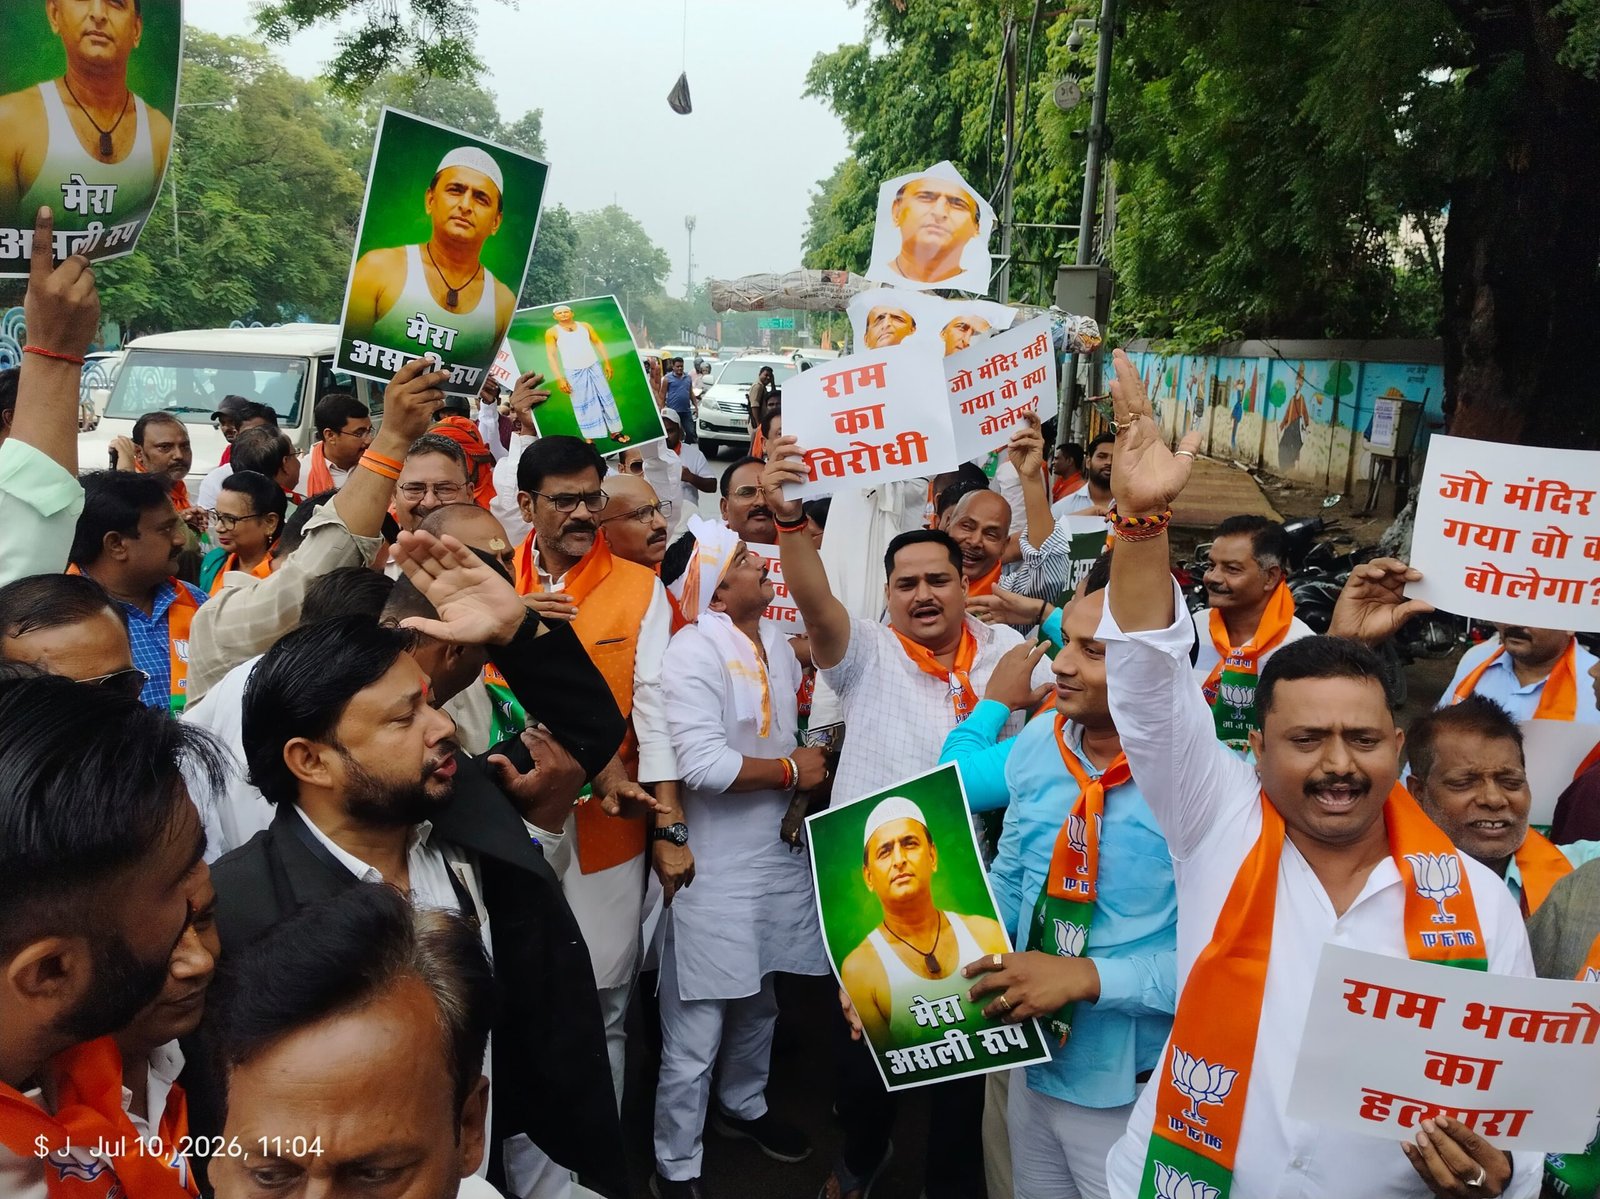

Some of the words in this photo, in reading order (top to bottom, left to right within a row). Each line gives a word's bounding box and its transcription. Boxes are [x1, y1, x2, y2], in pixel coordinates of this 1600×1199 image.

[61, 173, 118, 215] मेरा
[407, 312, 459, 350] मेरा
[350, 340, 444, 375] असी
[948, 369, 973, 393] जो
[977, 354, 1018, 380] मंदिर
[1021, 331, 1048, 360] नहीं
[820, 362, 887, 398] राम
[959, 390, 995, 415] गया
[999, 379, 1018, 399] वो
[1021, 366, 1046, 389] क्या
[831, 403, 885, 434] का
[802, 431, 929, 482] विरोधी
[1439, 470, 1493, 505] जो
[1504, 476, 1597, 516] मंदिर
[1443, 518, 1521, 554] गया
[1531, 525, 1573, 559] वो
[909, 994, 966, 1029] मेरा
[1343, 978, 1446, 1030] राम
[885, 1029, 975, 1075] असली
[1424, 1050, 1503, 1091] का
